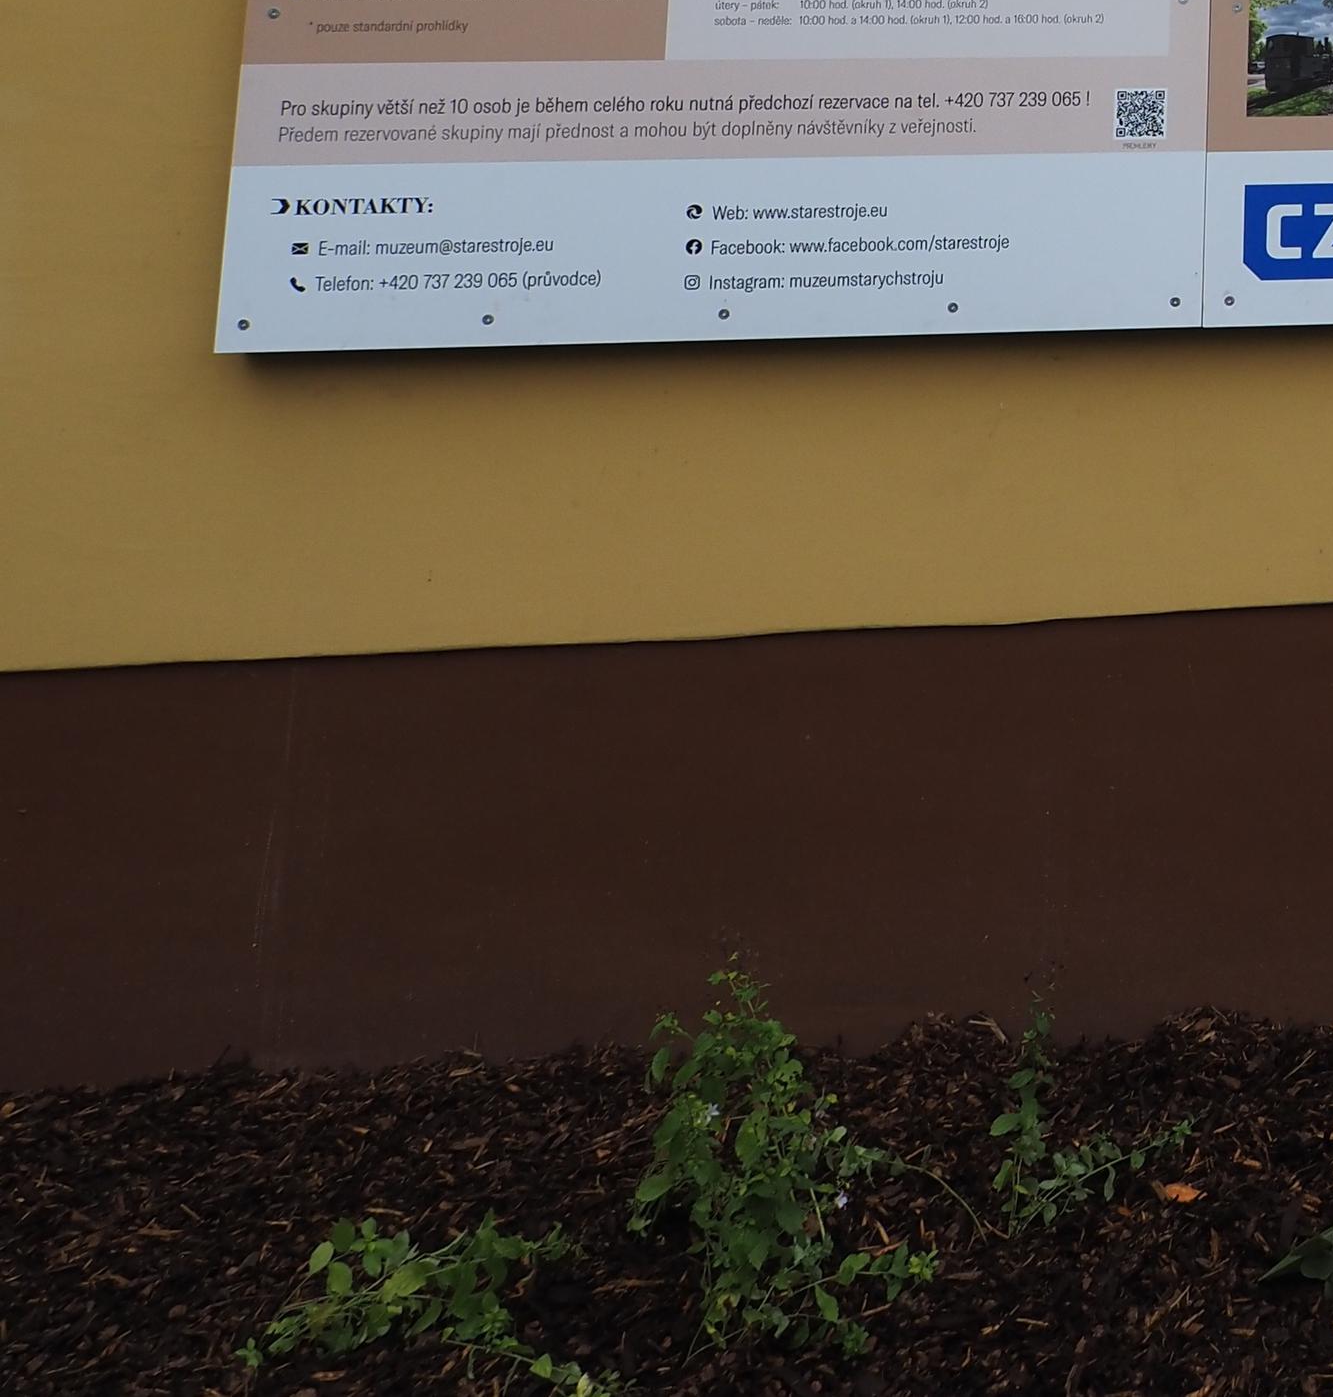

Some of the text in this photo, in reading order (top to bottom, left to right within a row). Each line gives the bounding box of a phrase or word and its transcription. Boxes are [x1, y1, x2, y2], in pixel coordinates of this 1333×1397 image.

[295, 197, 432, 215] KONTAKTY:
[712, 203, 887, 221] Web: www.starestroje.eu
[318, 238, 553, 256] E-mail: muzeum@starestroje.eu
[711, 234, 1009, 254] Facebook: www.facebook.com/starestroje
[709, 270, 943, 292] Instagram: muzeumstarychstroju
